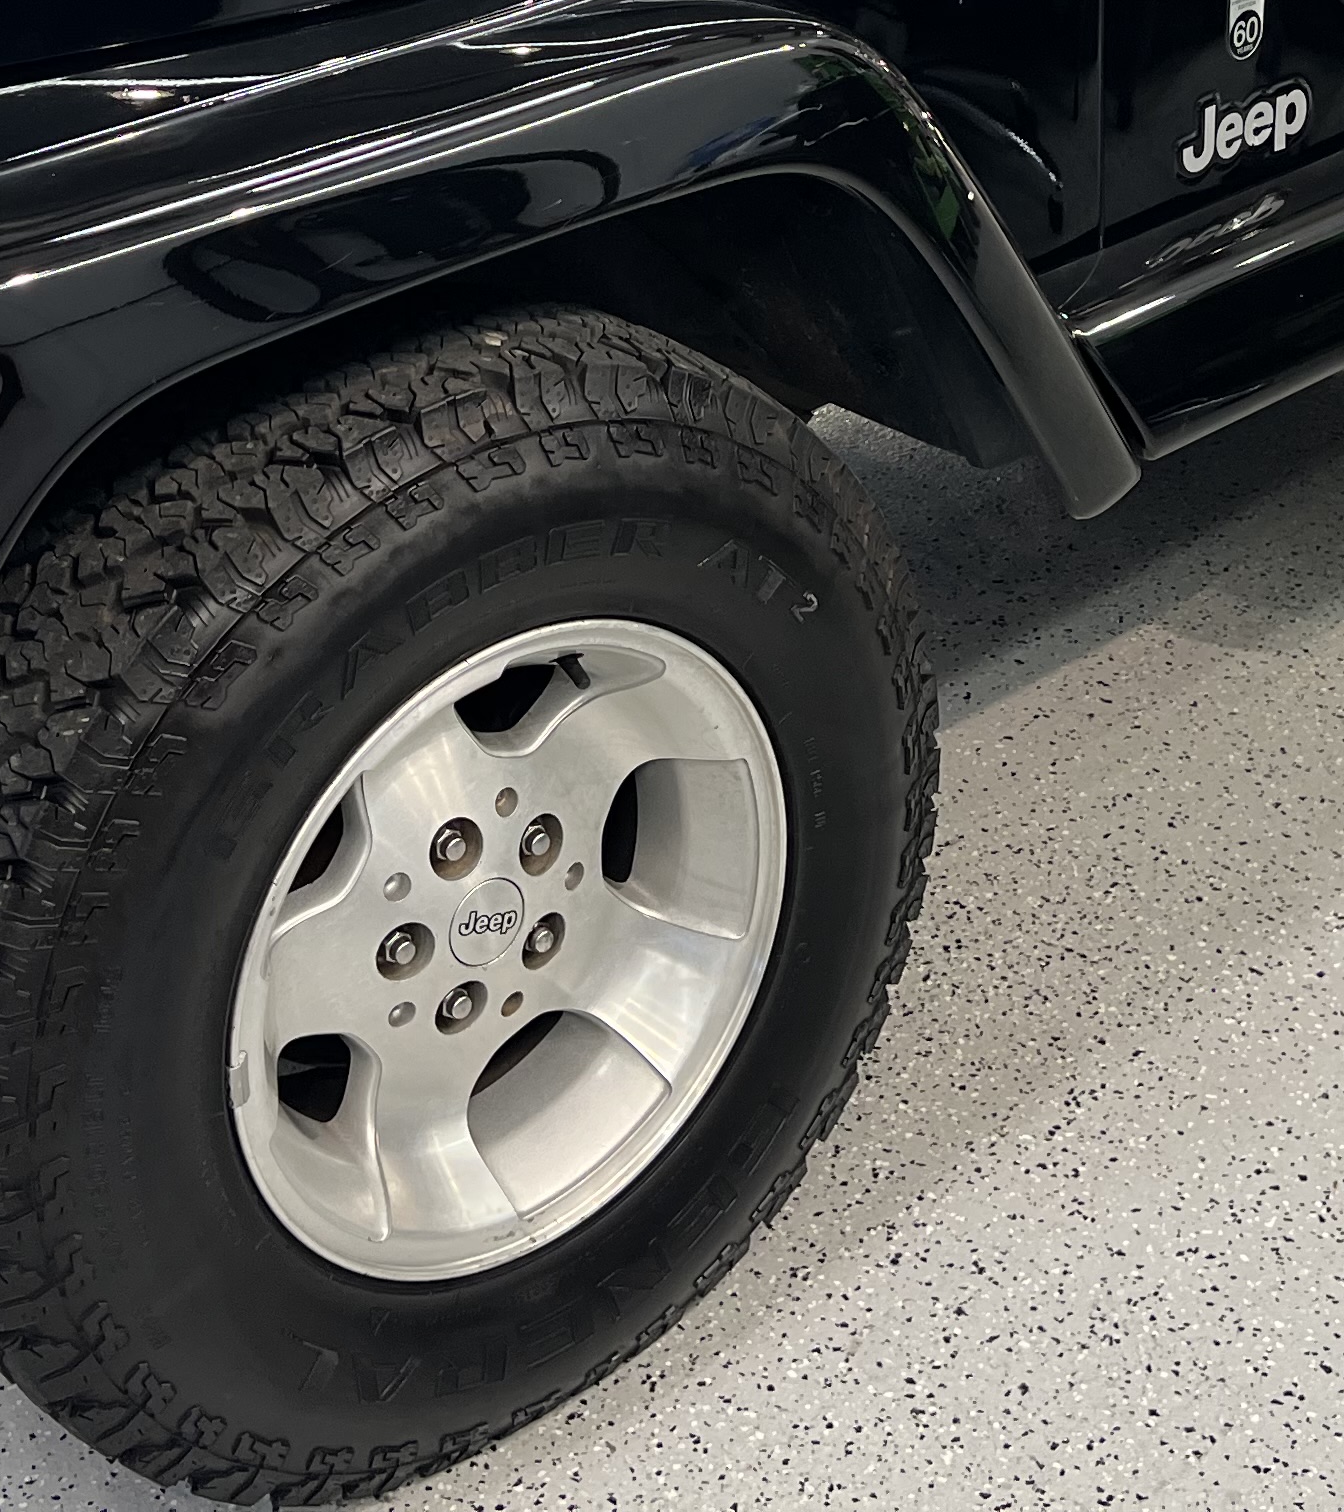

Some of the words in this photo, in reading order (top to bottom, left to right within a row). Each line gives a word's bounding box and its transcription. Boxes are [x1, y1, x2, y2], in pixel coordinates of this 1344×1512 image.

[1233, 16, 1259, 48] 60
[1180, 87, 1309, 175] Jeep
[458, 909, 518, 937] Jeep
